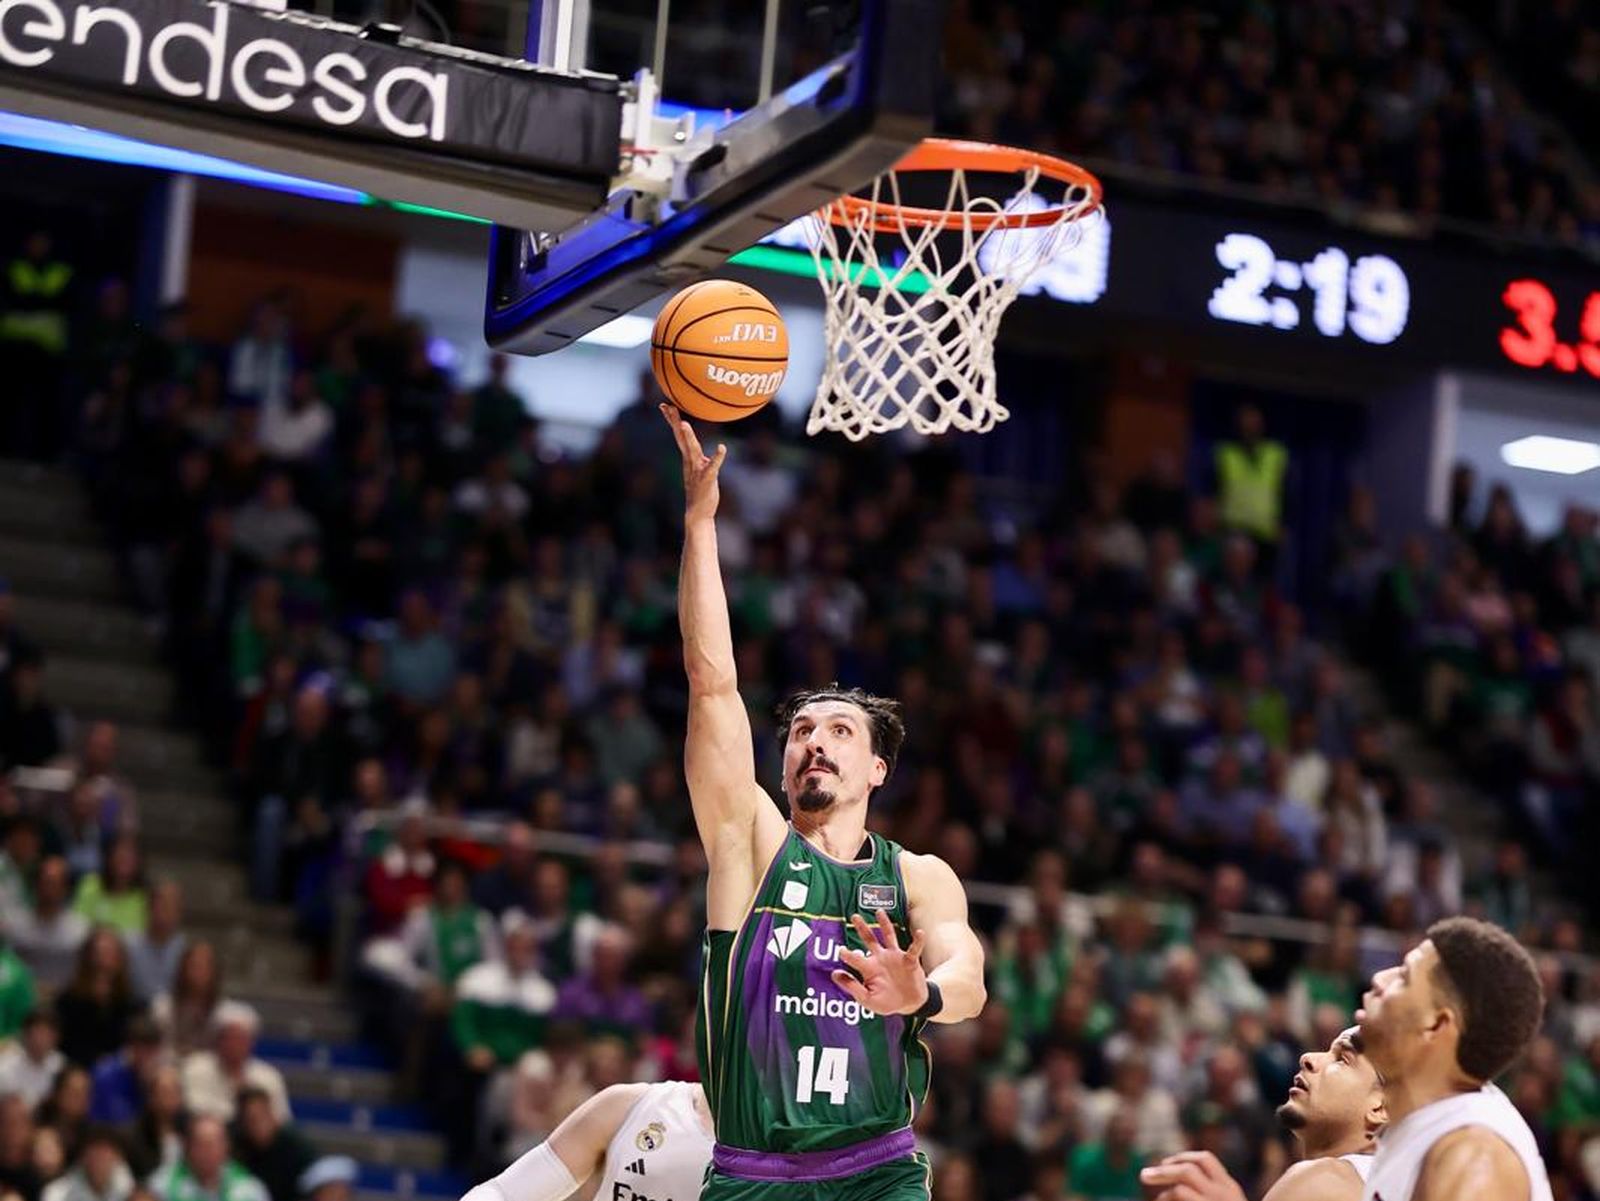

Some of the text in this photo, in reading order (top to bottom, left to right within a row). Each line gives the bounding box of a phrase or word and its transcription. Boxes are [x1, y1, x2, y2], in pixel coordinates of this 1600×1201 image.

[0, 0, 450, 141] endesa
[1208, 233, 1410, 344] 2:19
[707, 363, 783, 397] Wilson
[796, 1046, 849, 1105] 14
